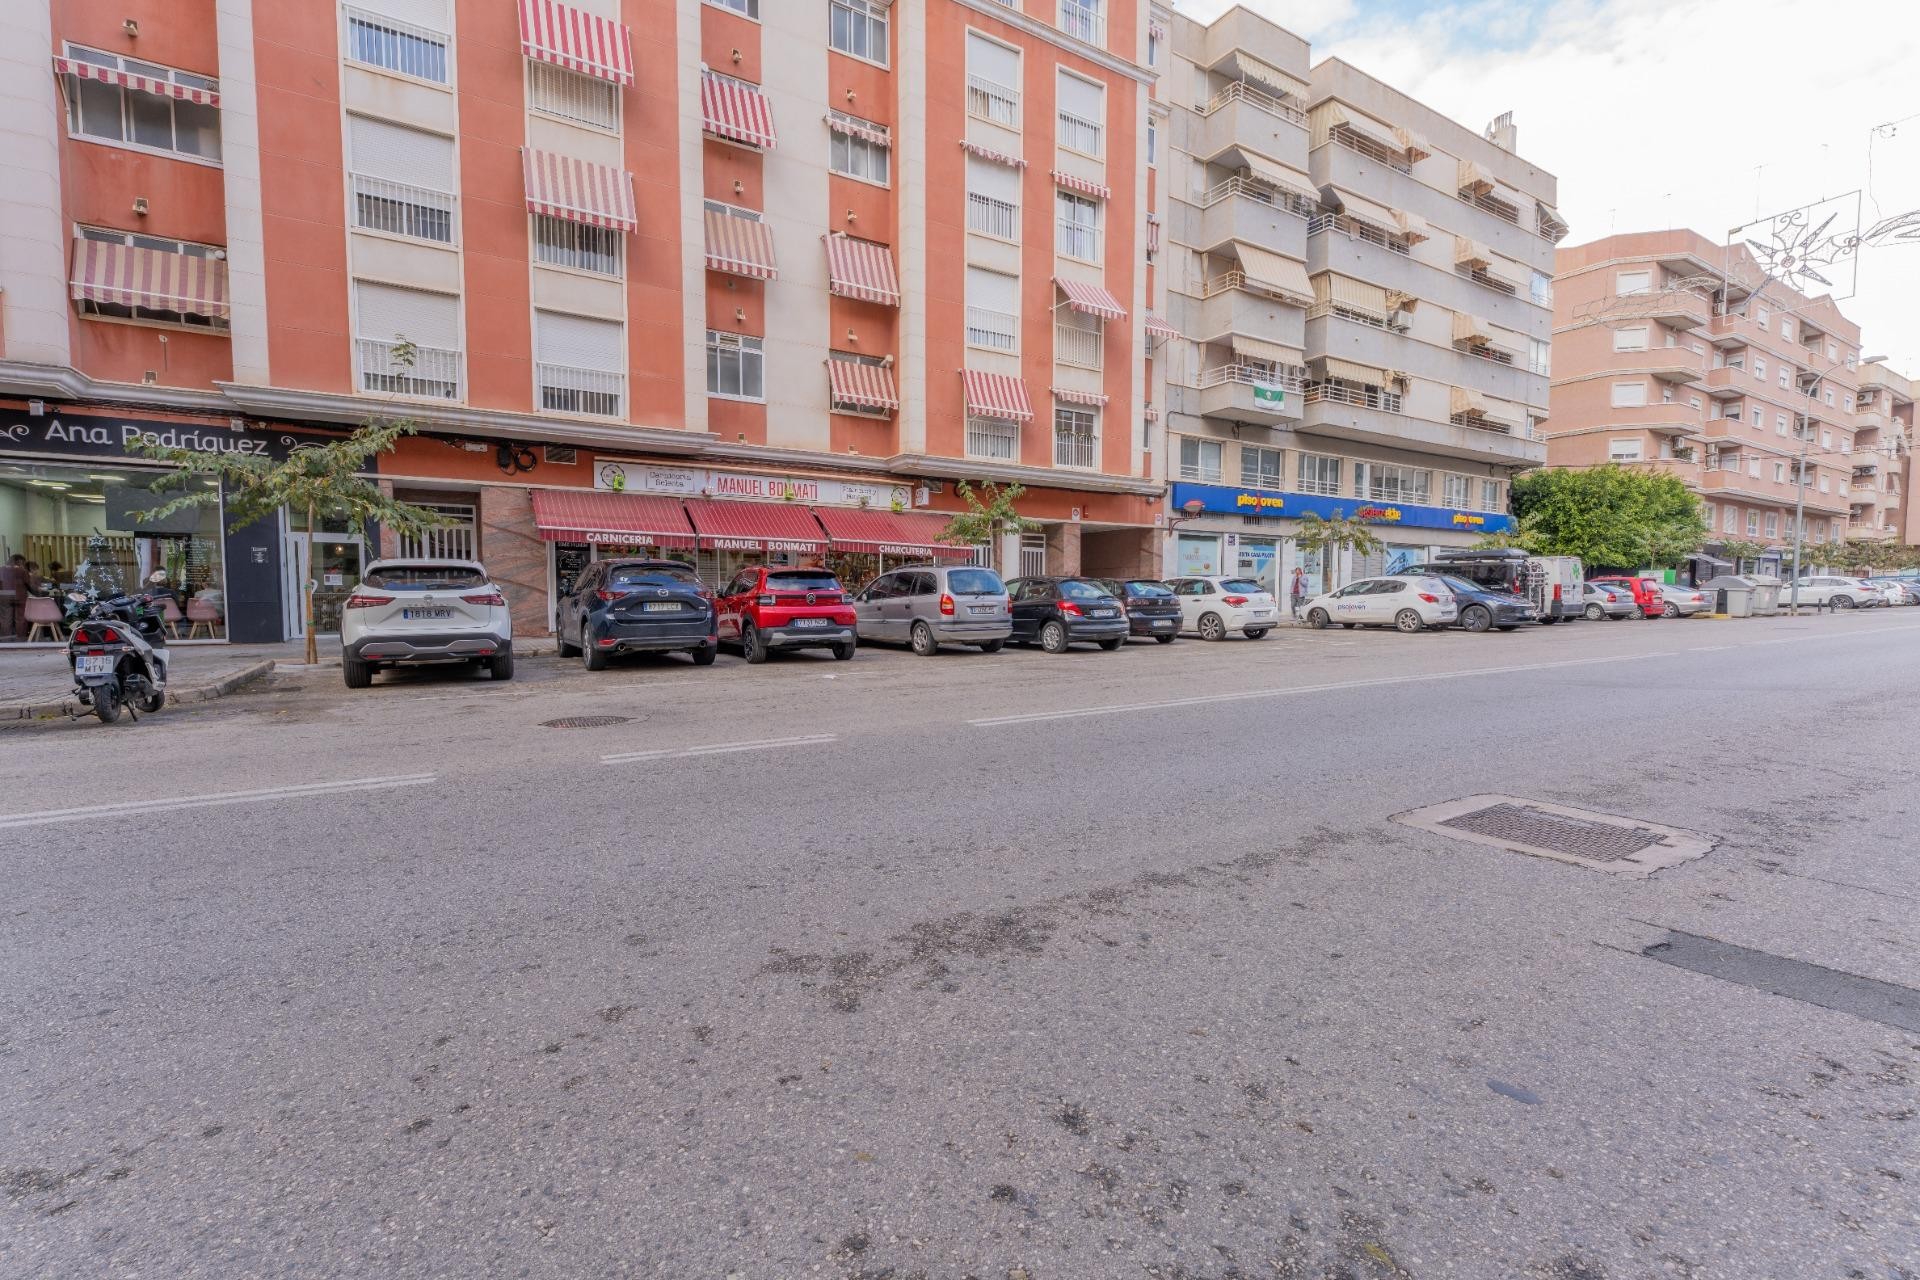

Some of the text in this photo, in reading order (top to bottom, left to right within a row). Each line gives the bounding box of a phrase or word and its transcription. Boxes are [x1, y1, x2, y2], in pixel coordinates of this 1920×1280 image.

[45, 420, 112, 444] Ana
[717, 477, 765, 496] MANUEL
[586, 533, 653, 545] CARNICERIA
[714, 539, 816, 552] MANUEL BONMATI
[879, 545, 932, 556] CHARCUTERIA
[435, 609, 451, 617] MRV
[84, 665, 105, 673] MTV
